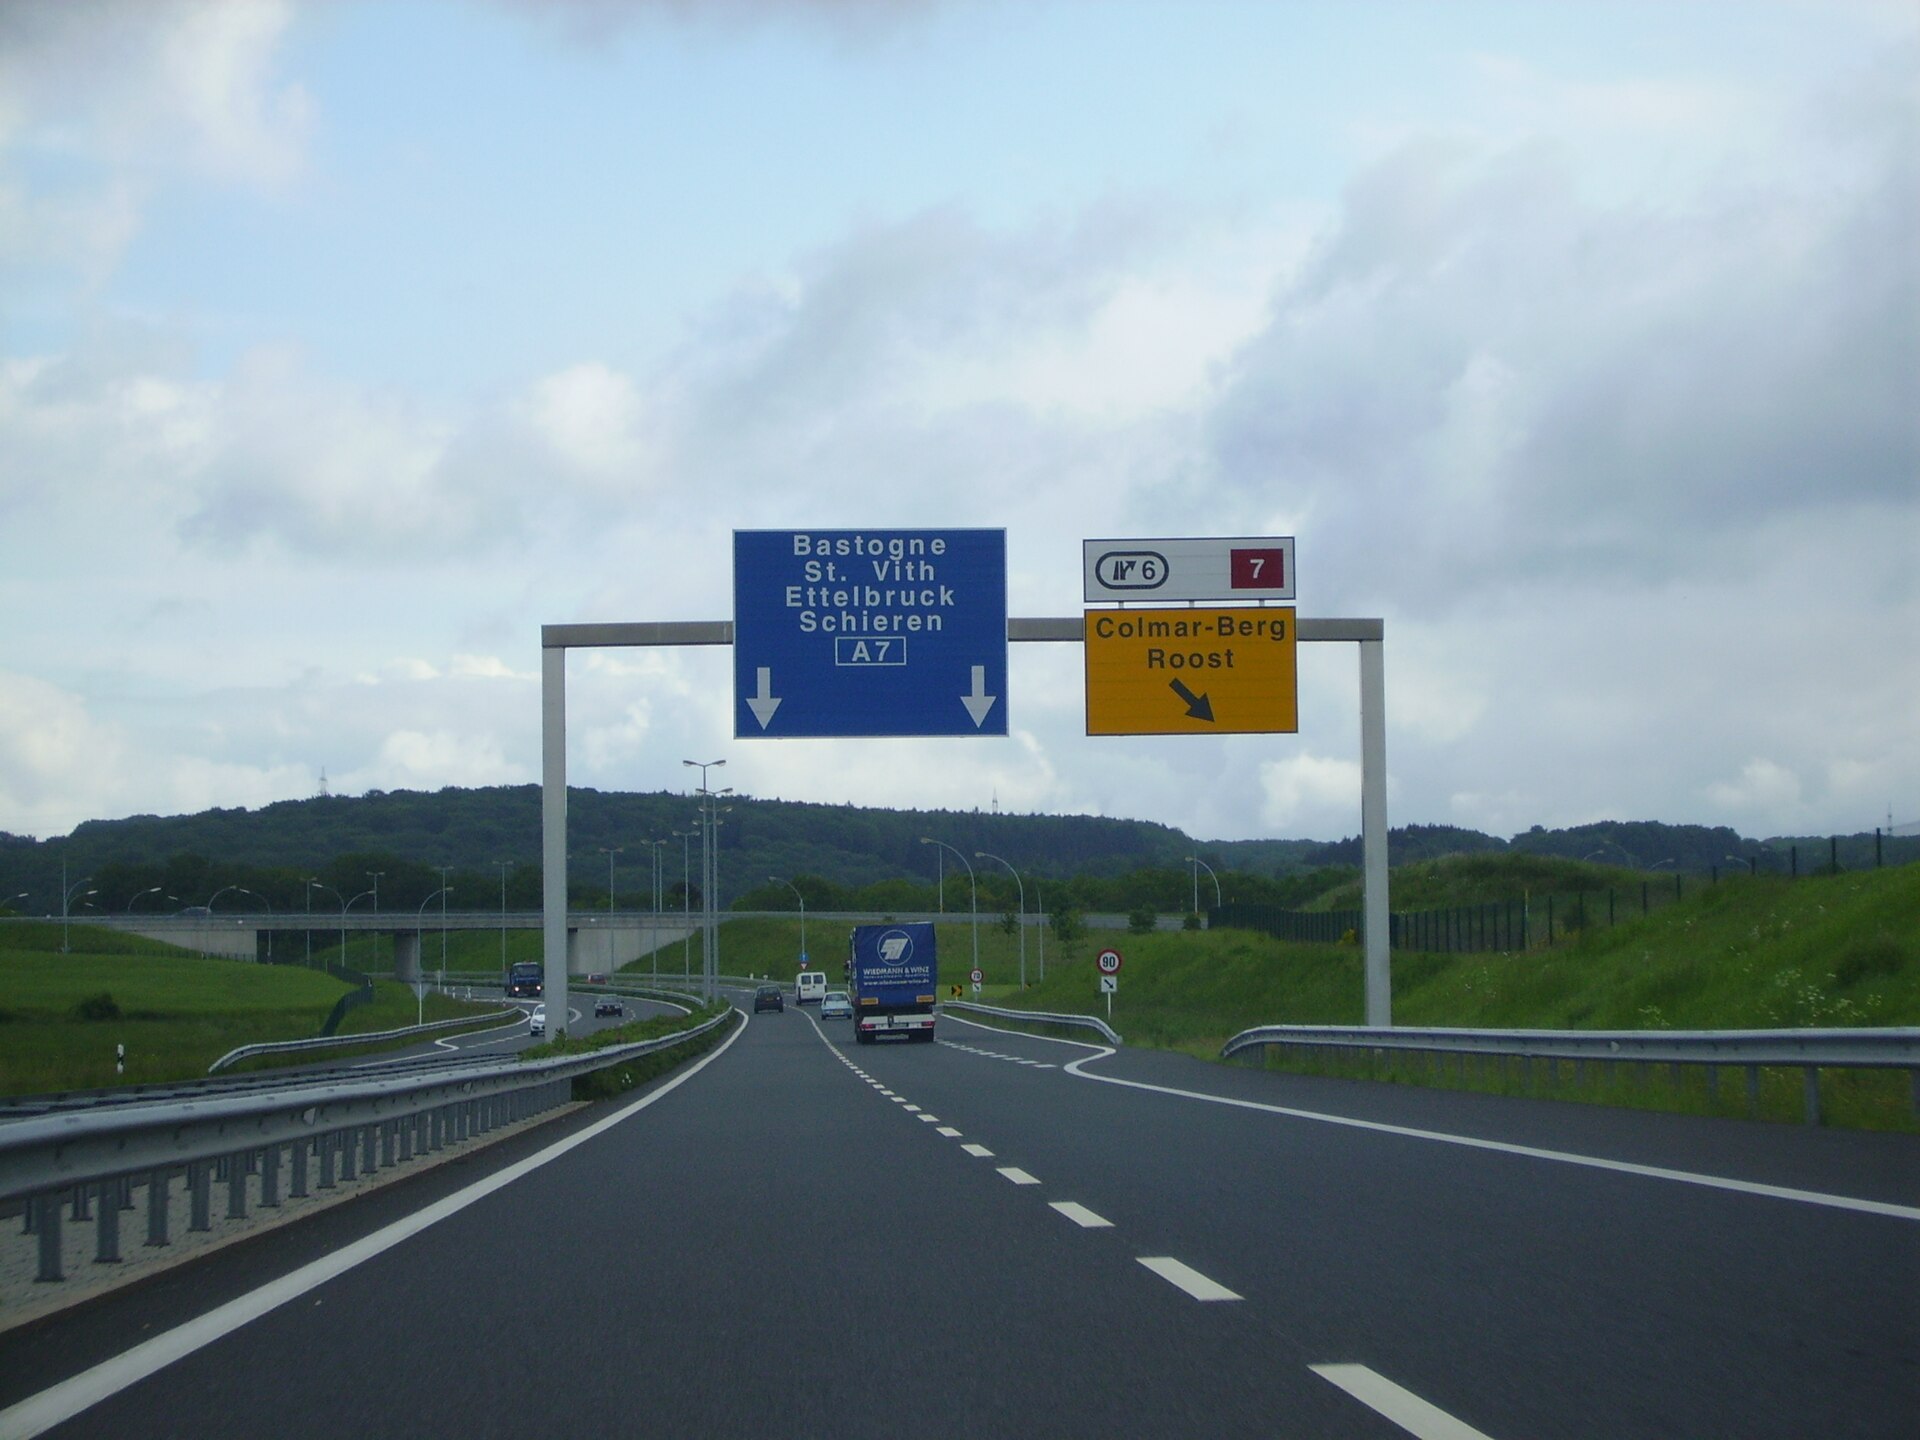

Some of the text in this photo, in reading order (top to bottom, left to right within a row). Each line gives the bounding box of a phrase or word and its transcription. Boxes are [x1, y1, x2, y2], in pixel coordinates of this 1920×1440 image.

[793, 534, 947, 561] Bastogne
[804, 560, 935, 582] St. Vith
[1142, 560, 1156, 580] 6
[1249, 558, 1265, 579] 7
[786, 585, 955, 607] Ettelbruck
[799, 610, 943, 633] Schieren
[1096, 615, 1286, 642] Colmar-Berg
[851, 640, 891, 663] A7
[1147, 648, 1235, 670] Roost
[863, 967, 903, 975] WIEDMANN
[1102, 956, 1116, 968] 90
